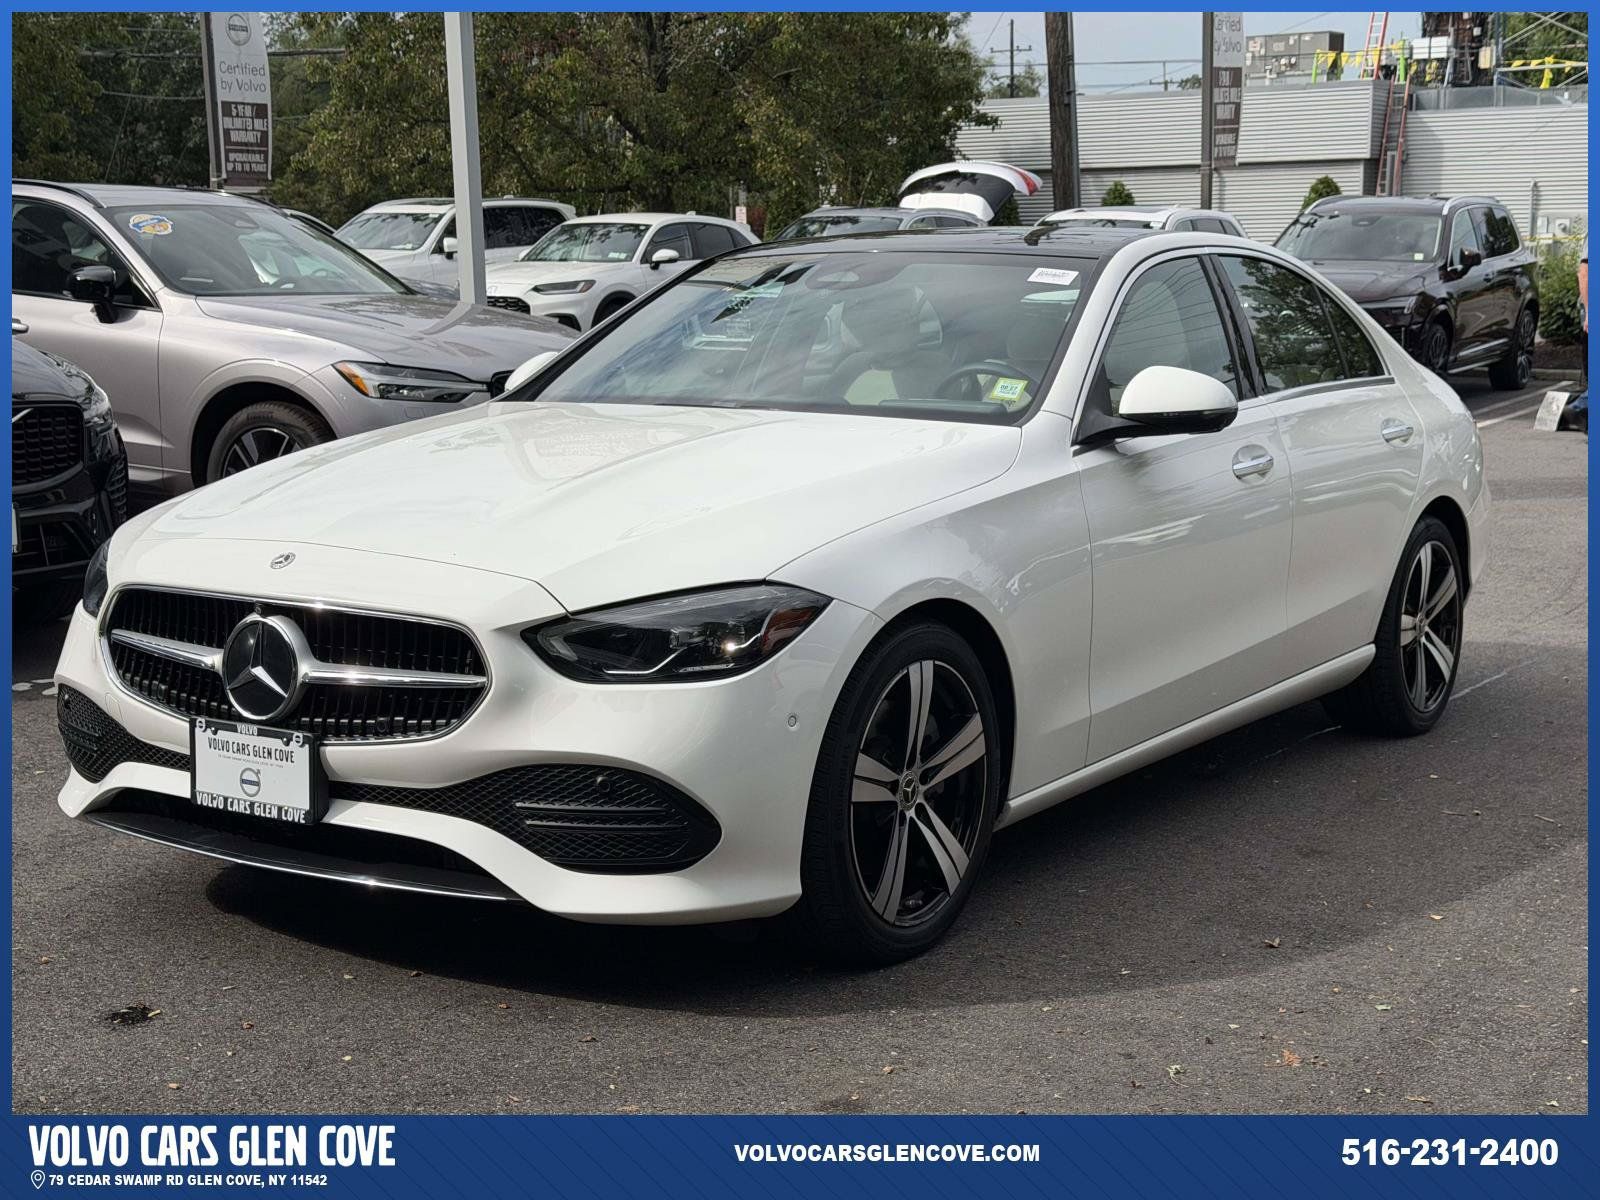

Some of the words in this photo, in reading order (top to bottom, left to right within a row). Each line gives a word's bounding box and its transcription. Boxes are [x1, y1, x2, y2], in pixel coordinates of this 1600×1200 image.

[219, 61, 266, 77] Certified
[220, 78, 233, 93] by
[236, 79, 267, 93] Volvo
[229, 130, 261, 144] WARRANTY
[236, 723, 258, 736] VOLVO
[207, 737, 230, 753] VOLVO
[231, 742, 251, 757] CARS
[252, 745, 273, 760] GLEN
[274, 748, 295, 763] COVE
[196, 791, 225, 809] VOLVO
[227, 798, 251, 814] CARS
[253, 803, 278, 819] GLEN
[281, 807, 306, 823] COVE
